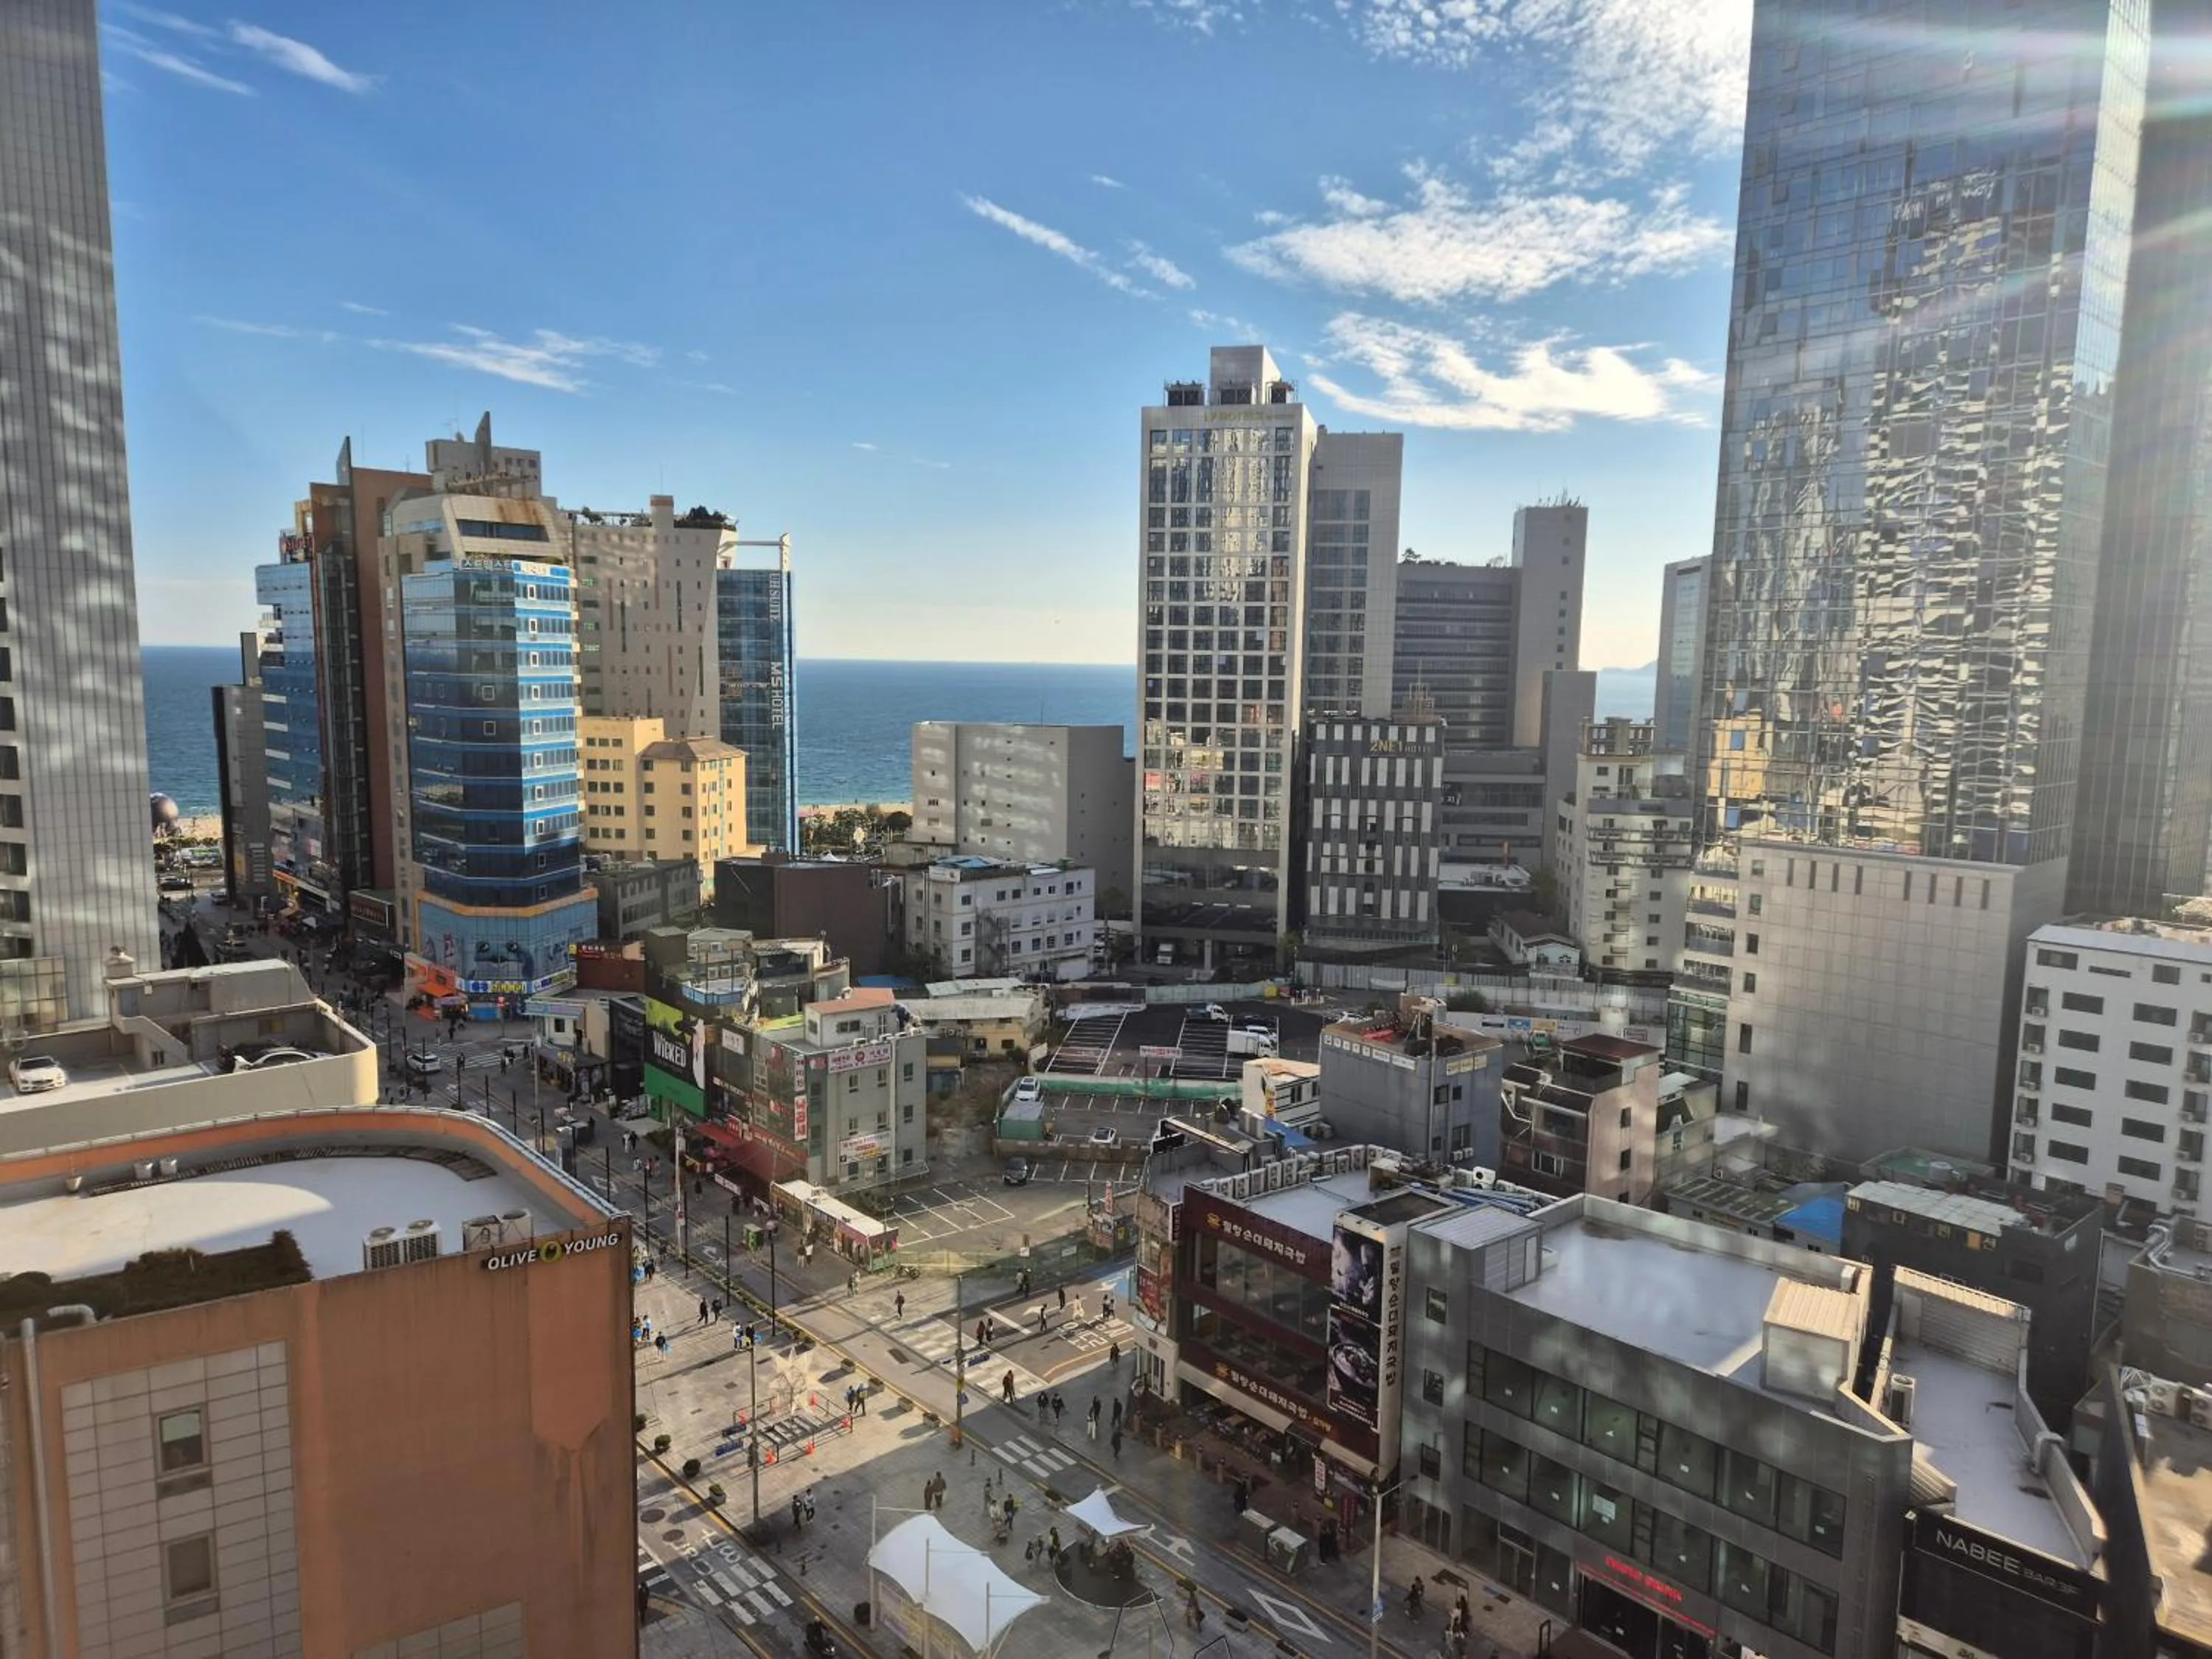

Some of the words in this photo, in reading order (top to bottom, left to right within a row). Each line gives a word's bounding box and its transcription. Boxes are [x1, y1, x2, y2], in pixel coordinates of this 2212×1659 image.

[771, 690, 784, 729] HOTEL
[487, 1250, 538, 1270] OLIVE
[564, 1234, 619, 1254] YOUNG
[1936, 1530, 2021, 1575] NABEE
